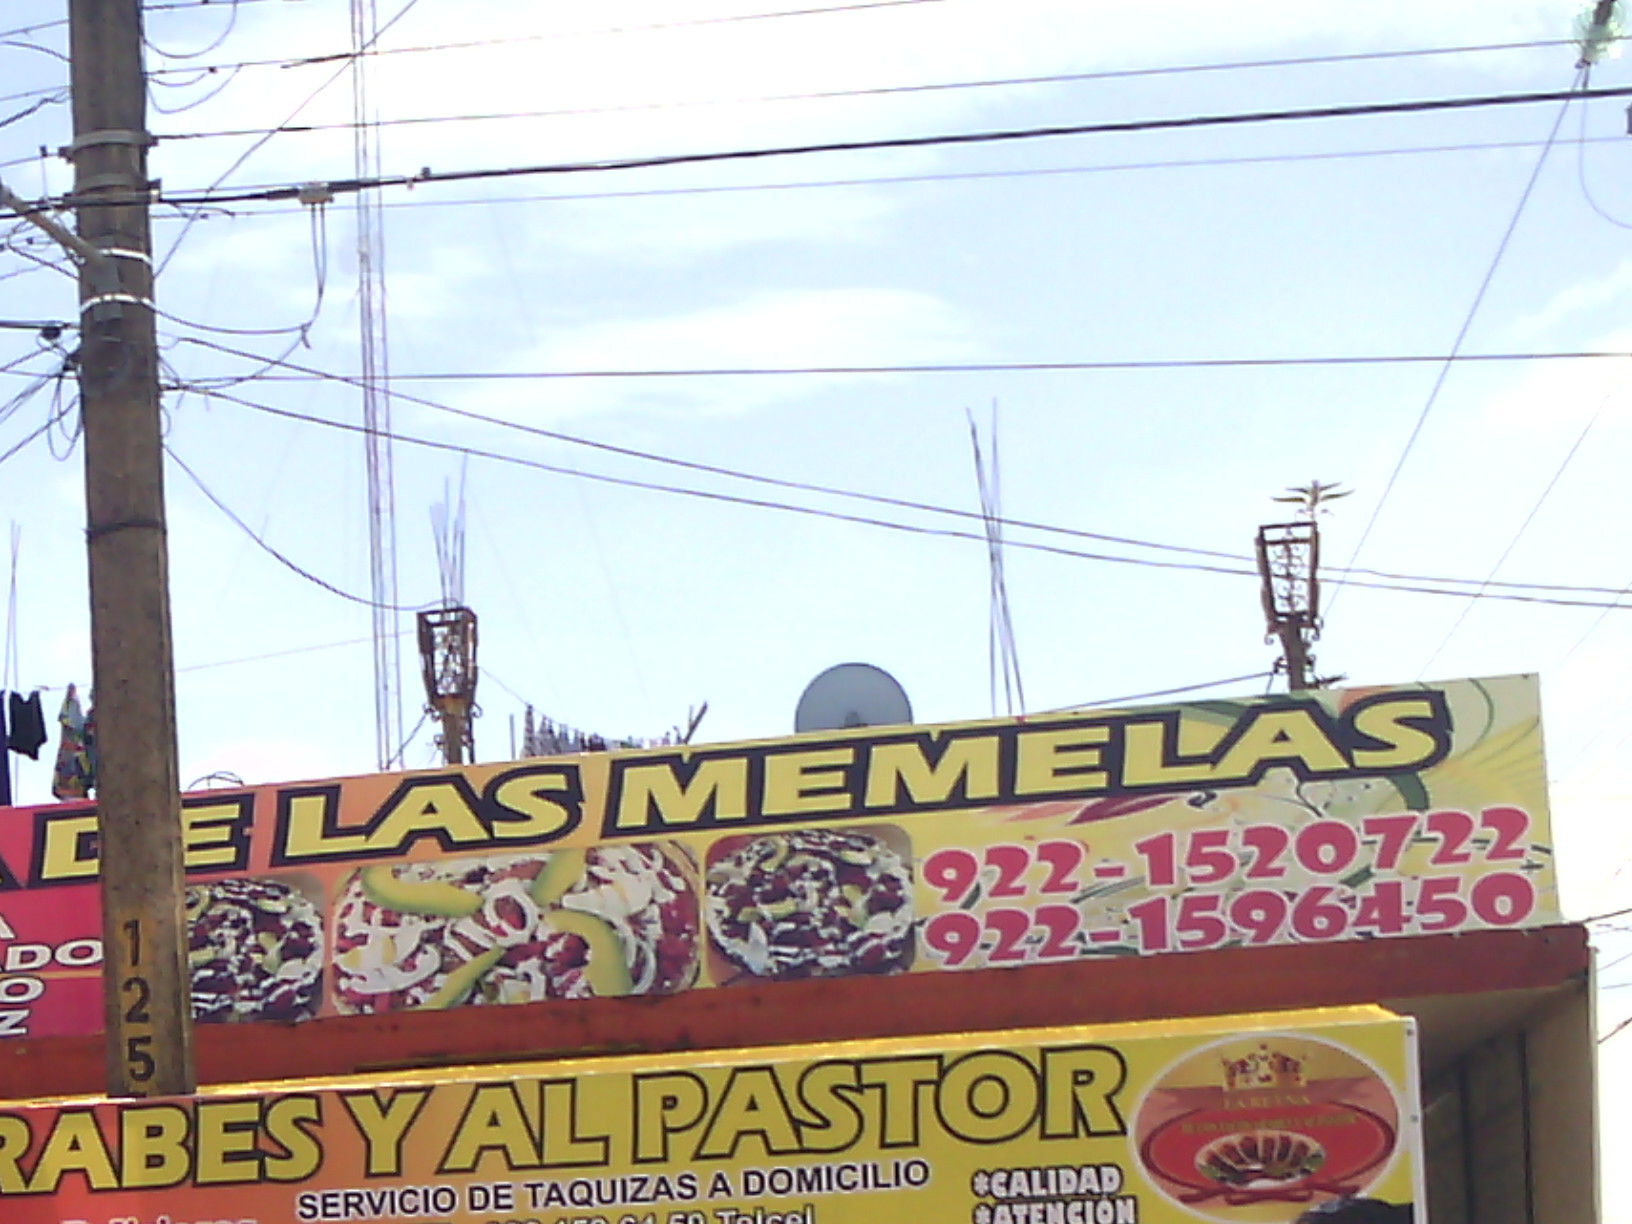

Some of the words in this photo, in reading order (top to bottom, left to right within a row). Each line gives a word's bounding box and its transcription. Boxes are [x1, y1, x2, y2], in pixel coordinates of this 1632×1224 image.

[277, 769, 577, 863] LAS
[610, 695, 1447, 833] MEMELAS
[922, 808, 1530, 902] 922-1520722
[922, 875, 1535, 967] 922-1596450
[343, 1087, 432, 1176] Y
[439, 1078, 611, 1171] AL
[632, 1045, 1130, 1163] PASTOR
[296, 1185, 458, 1221] SERVICIO
[468, 1182, 514, 1212] DE
[525, 1173, 699, 1210] TAQUIZAS
[708, 1171, 734, 1200] A
[742, 1160, 932, 1197] DOMICILIO
